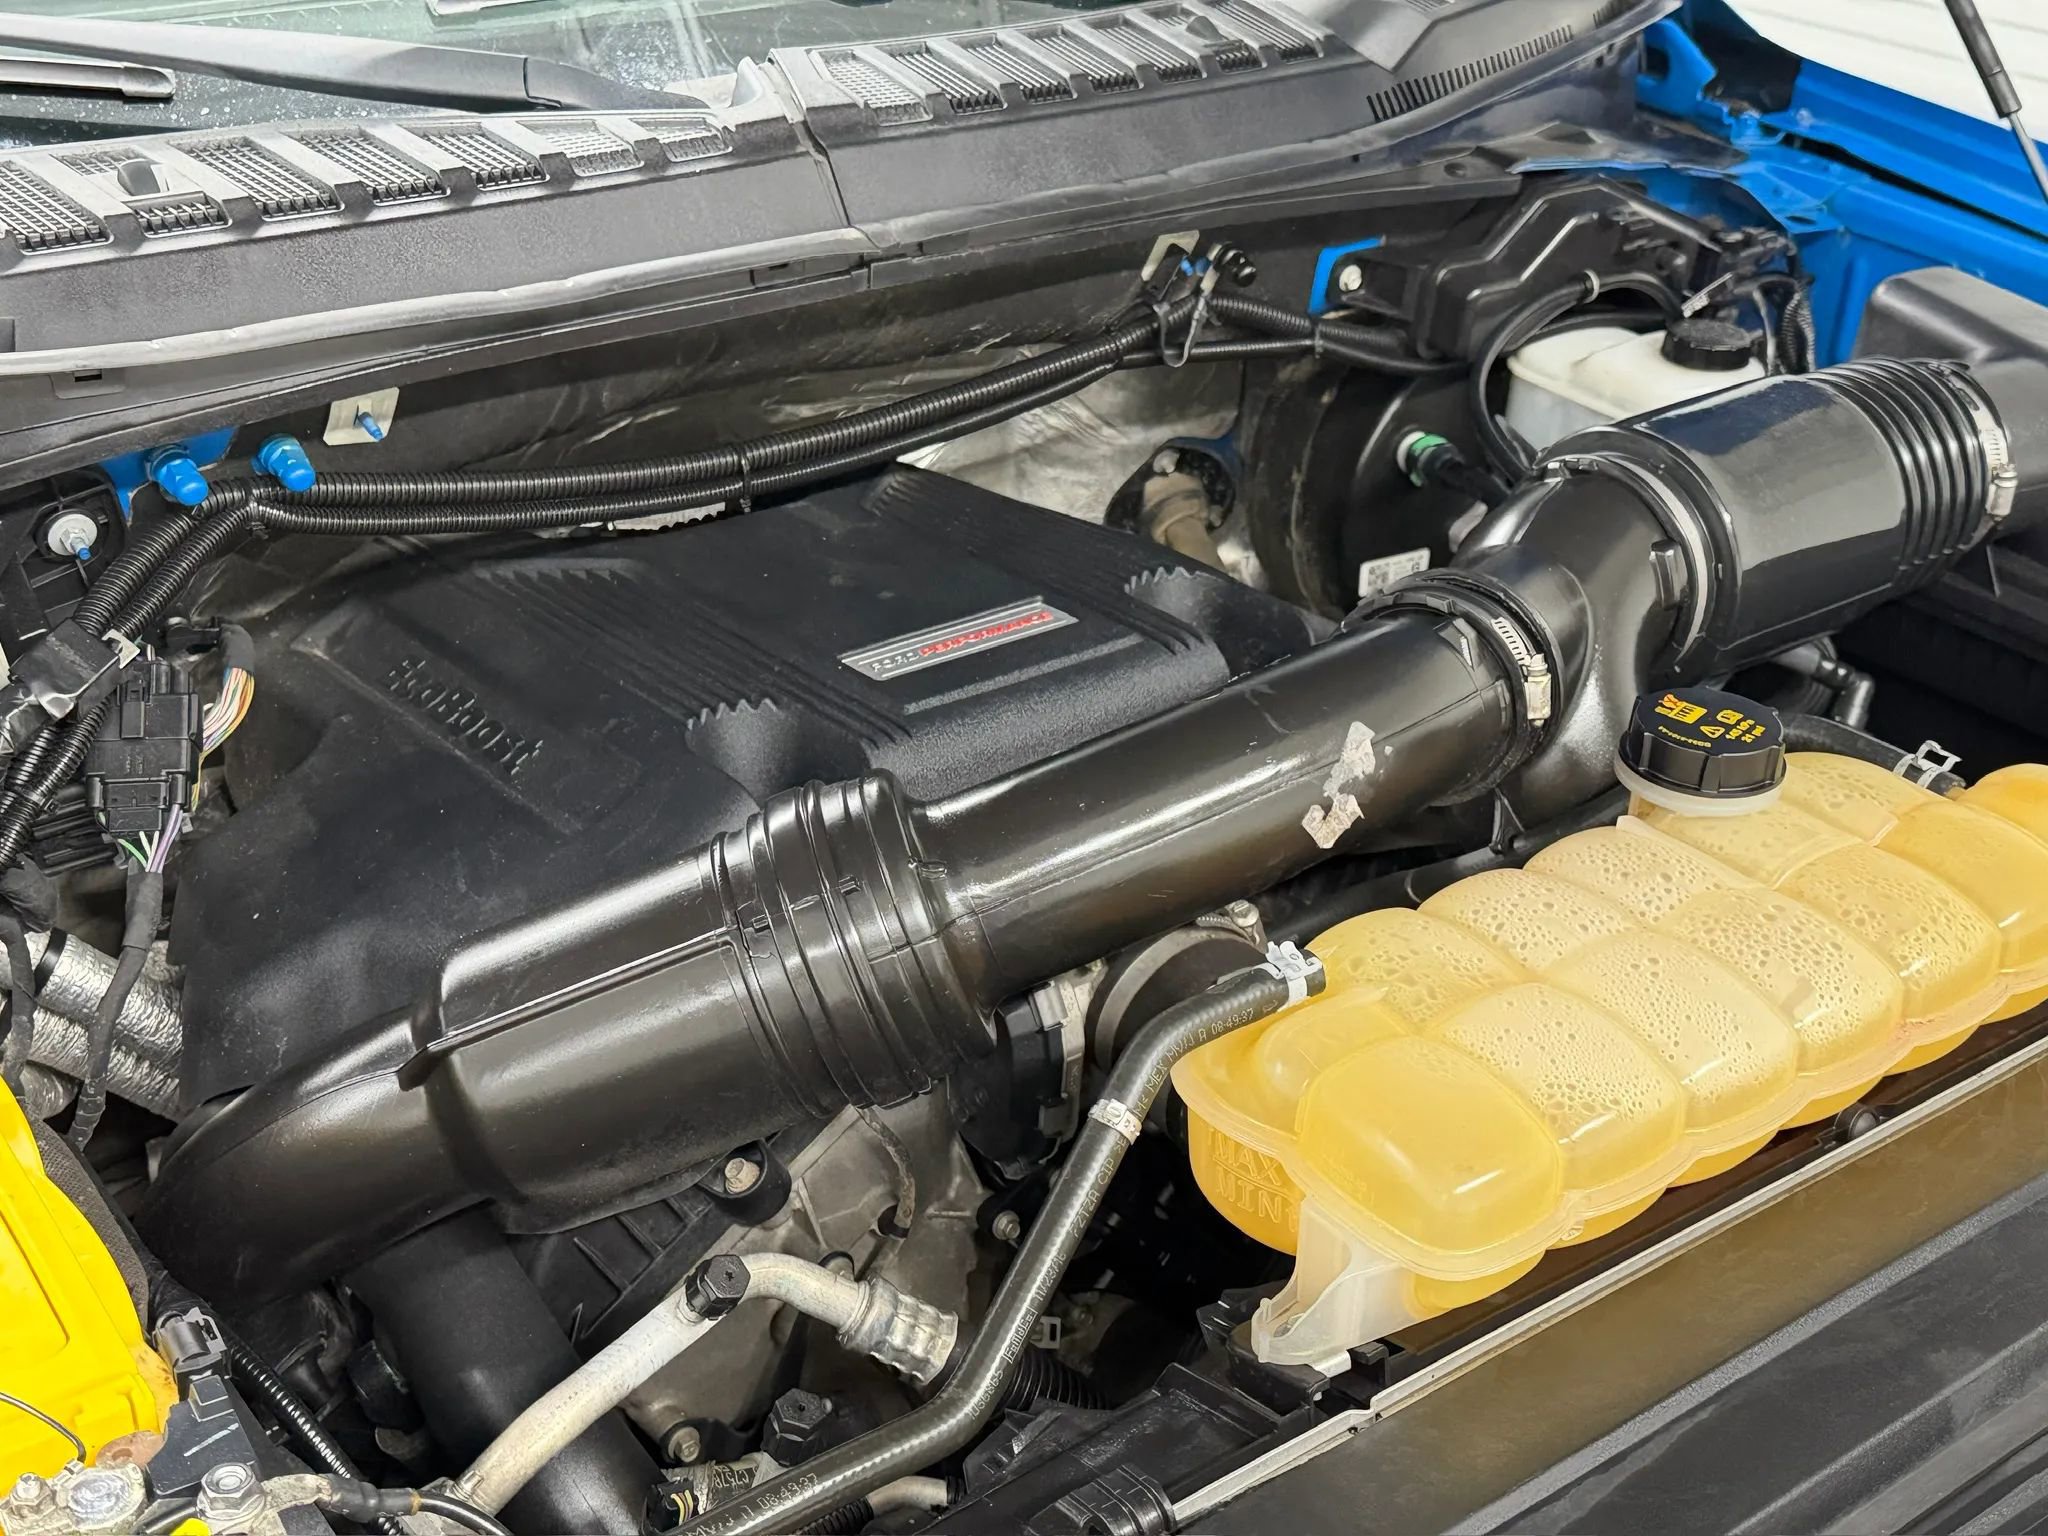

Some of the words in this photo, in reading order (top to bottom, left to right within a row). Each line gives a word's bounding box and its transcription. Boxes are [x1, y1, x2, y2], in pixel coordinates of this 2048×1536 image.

[919, 611, 1054, 657] PERFORMANCE
[1096, 1163, 1116, 1187] CIP
[1144, 1057, 1170, 1095] MEX
[1210, 1007, 1255, 1037] 08:49:37
[1214, 1128, 1282, 1187] MAX
[1215, 1166, 1283, 1224] MIN
